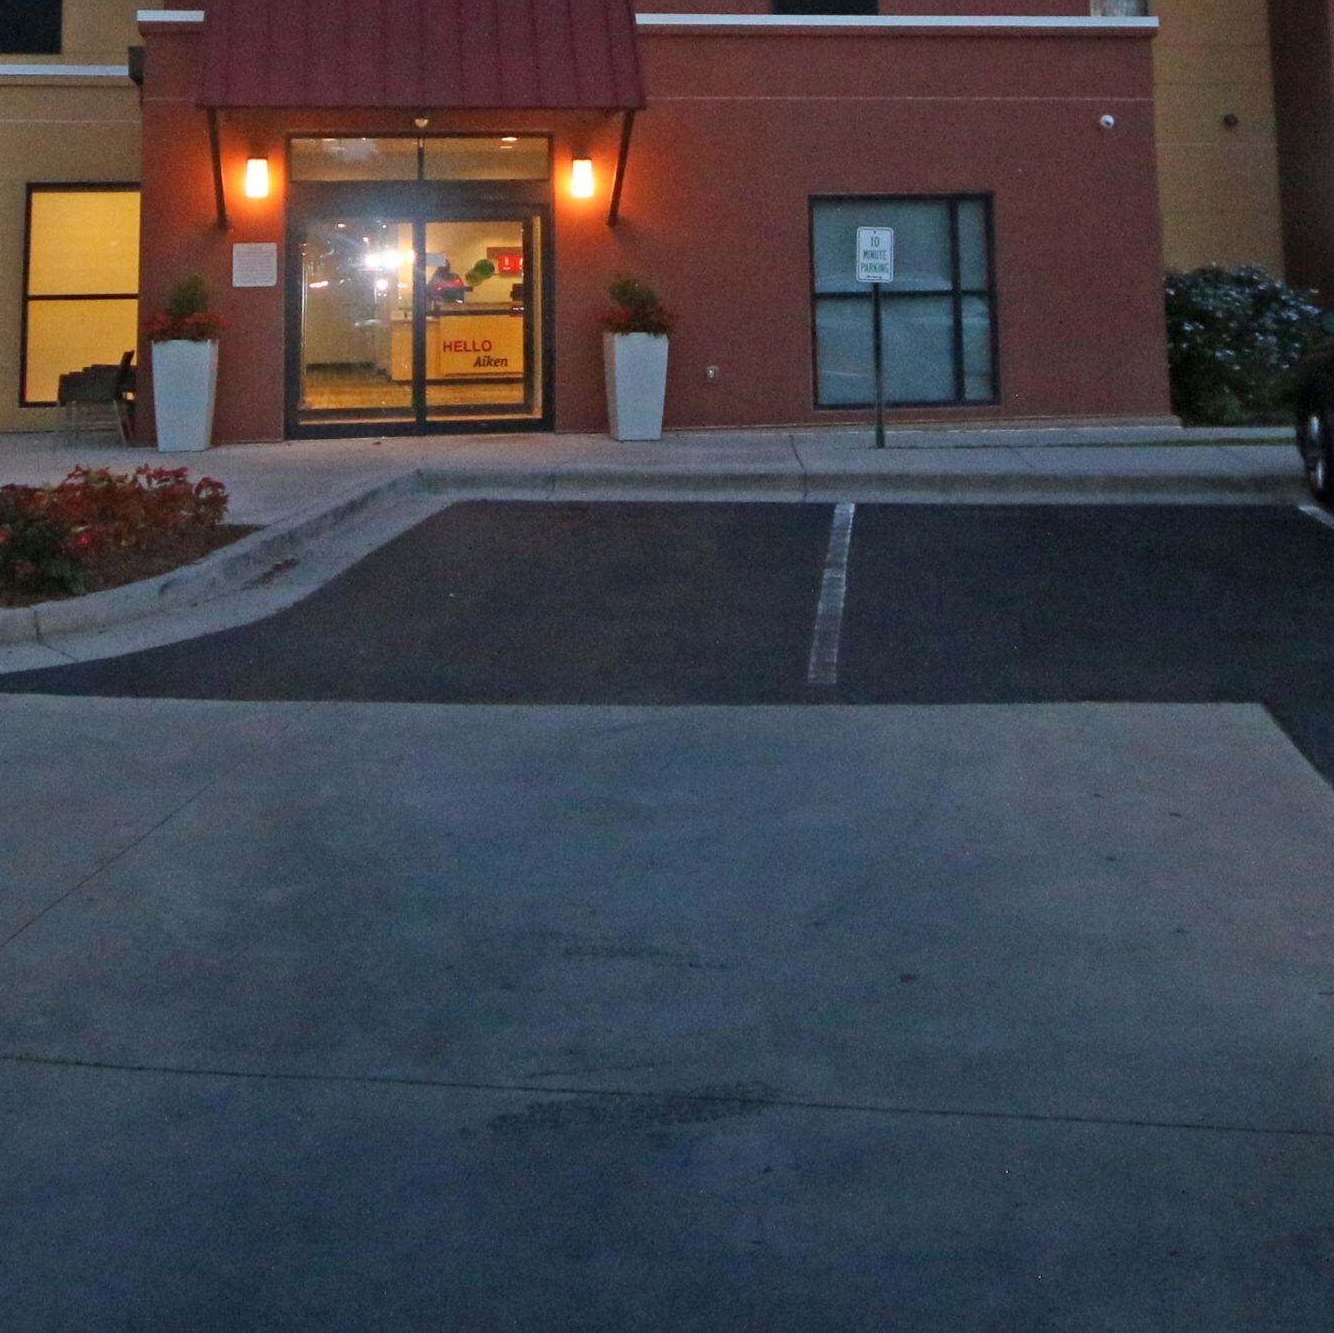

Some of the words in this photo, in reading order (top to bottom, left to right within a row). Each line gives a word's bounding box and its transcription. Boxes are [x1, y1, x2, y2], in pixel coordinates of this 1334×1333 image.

[870, 236, 880, 247] 10
[863, 250, 886, 260] MINUTE
[443, 340, 492, 353] HELLO
[474, 355, 508, 367] Aiken
